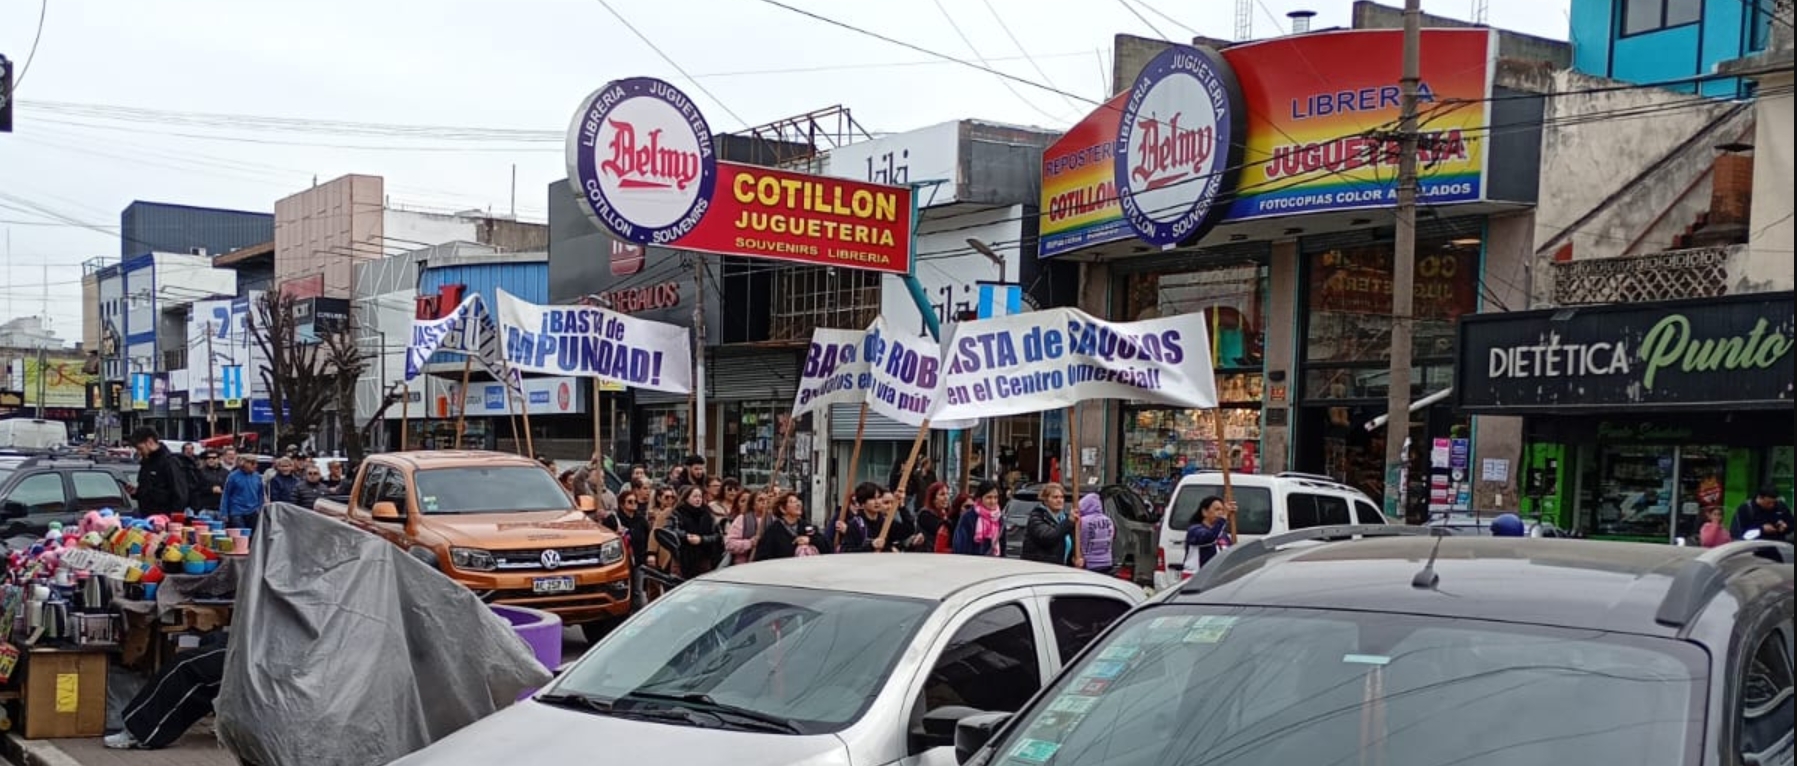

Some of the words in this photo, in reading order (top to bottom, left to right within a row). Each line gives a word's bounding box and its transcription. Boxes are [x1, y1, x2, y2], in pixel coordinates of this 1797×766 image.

[1170, 53, 1226, 122] JUGUETERIA
[1291, 82, 1435, 121] LIBRERA
[586, 85, 626, 148] LIBRERIA
[649, 81, 712, 159] JUGUETERIA
[1118, 76, 1152, 153] LIBRERIA
[586, 179, 633, 237] COTILLON
[652, 198, 709, 244] SOUVENIRS
[733, 172, 898, 222] COTILLON
[1120, 186, 1156, 238] COTILLON
[1172, 169, 1224, 238] SOUVENIRS
[1258, 193, 1334, 211] FOTOCOPIAS
[1335, 189, 1383, 204] COLOR
[734, 210, 896, 247] JUGUETERIA
[734, 236, 819, 256] SOUVENIRS
[827, 247, 890, 264] LIBRERIA
[605, 316, 626, 341] de
[1022, 325, 1064, 363] de
[1488, 333, 1631, 378] DIETÉTICA
[1640, 314, 1795, 391] Punto
[884, 340, 939, 390] ROB
[947, 384, 971, 406] en
[972, 377, 994, 402] el
[995, 369, 1064, 398] Centro
